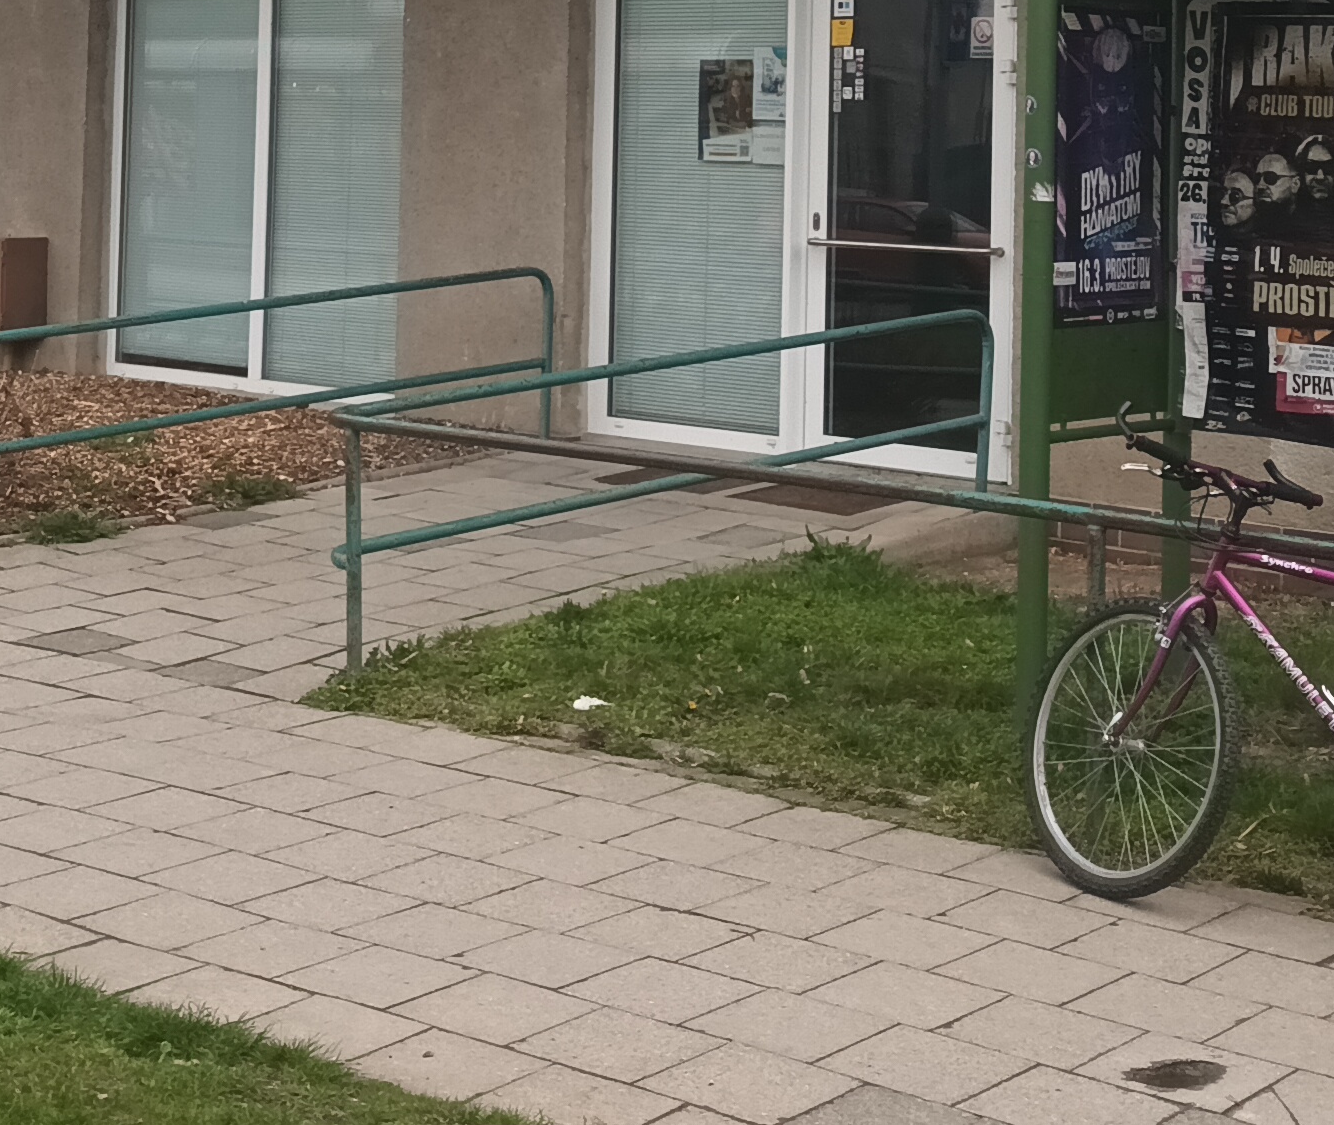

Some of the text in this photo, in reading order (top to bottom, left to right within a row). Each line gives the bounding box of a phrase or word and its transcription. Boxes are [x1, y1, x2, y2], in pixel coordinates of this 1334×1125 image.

[1260, 94, 1298, 116] CLUB
[1179, 182, 1207, 204] 26.
[1254, 246, 1265, 272] 1.
[1269, 246, 1284, 273] 4.
[1078, 253, 1151, 293] 16.3. PROSTĚJOV
[1260, 554, 1313, 574] Synchro
